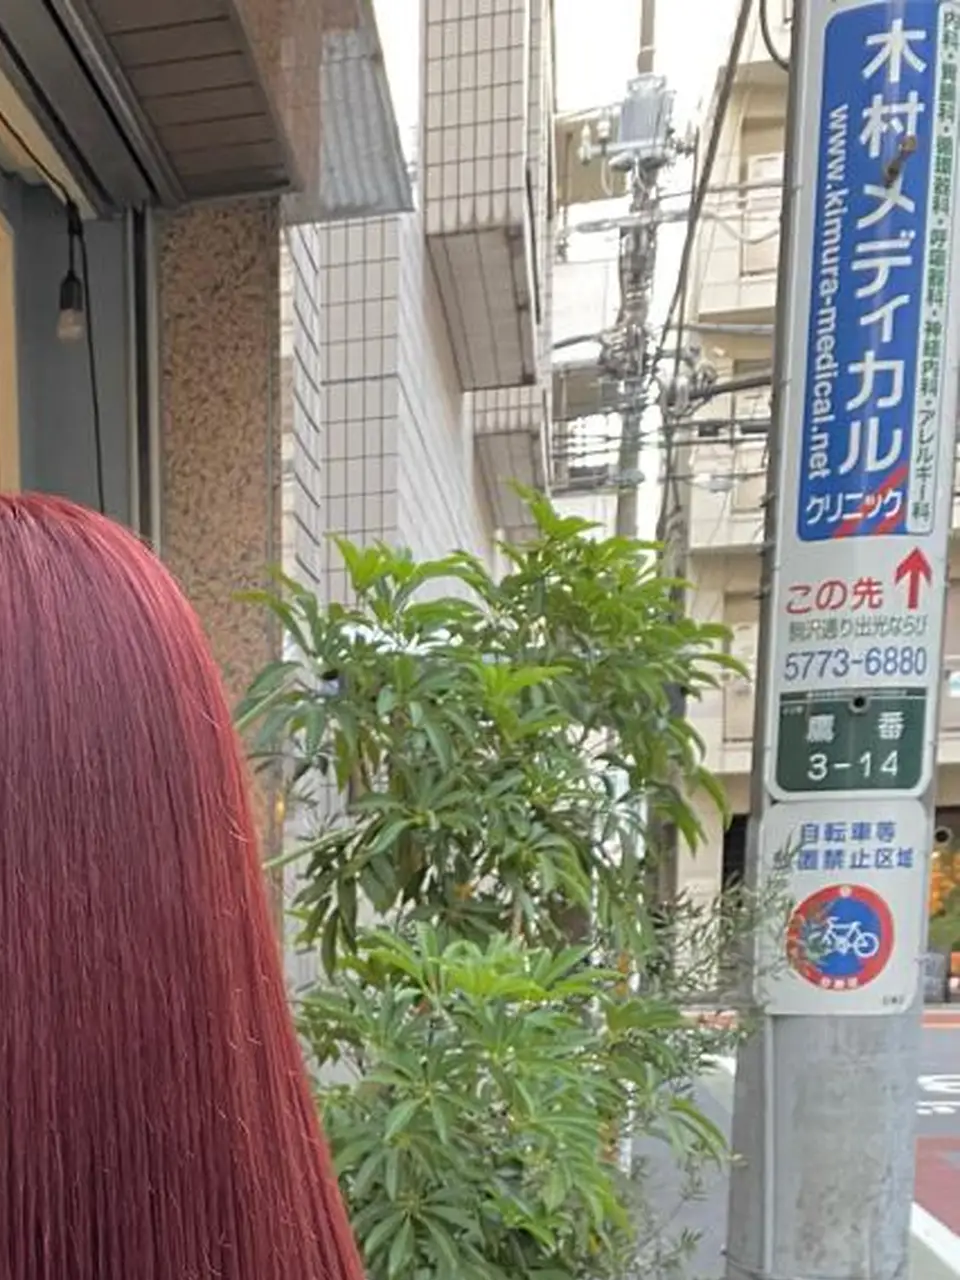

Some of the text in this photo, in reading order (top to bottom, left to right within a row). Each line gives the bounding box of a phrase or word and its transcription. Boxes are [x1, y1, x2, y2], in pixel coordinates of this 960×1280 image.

[839, 18, 927, 475] 木村メディカル
[809, 104, 849, 480] www.kimura-medical.net
[806, 488, 902, 525] クリニック
[786, 577, 884, 615] この先
[784, 646, 928, 681] 5773-6880
[807, 751, 899, 781] 3-14
[801, 821, 897, 844] 自転車等
[775, 847, 914, 871] 置禁止区域
